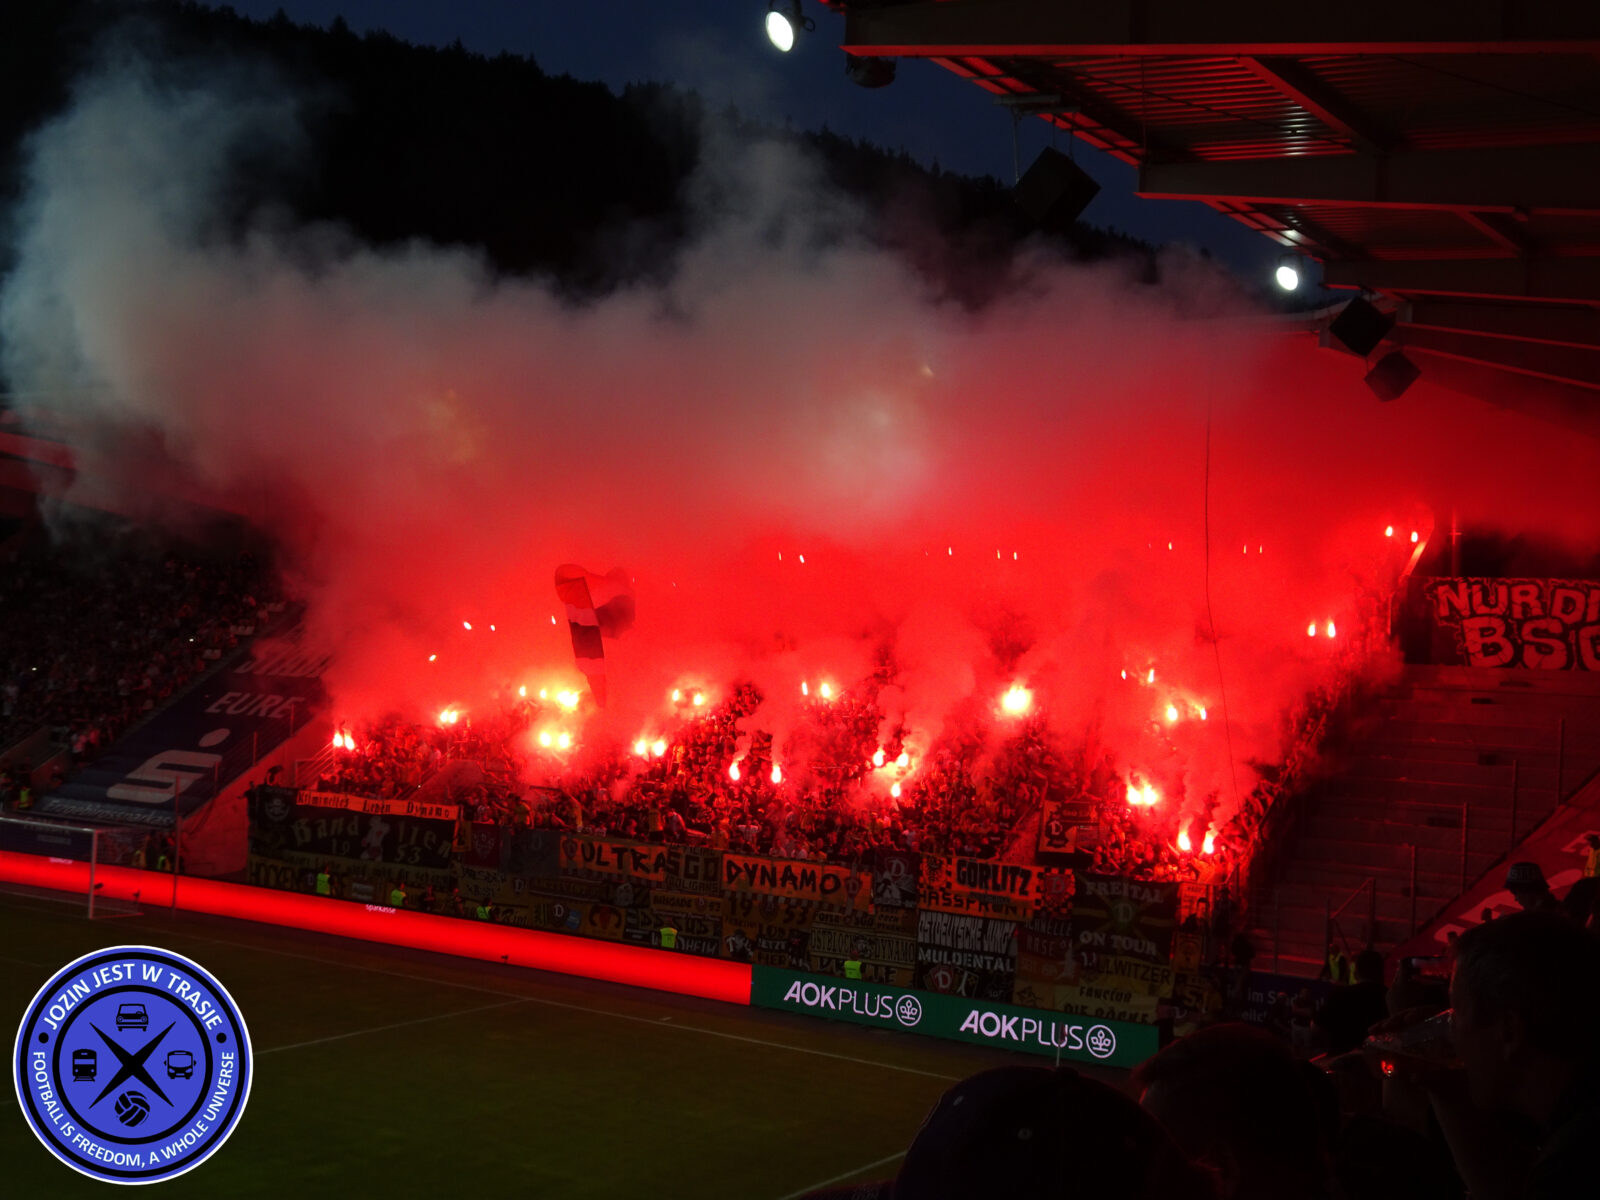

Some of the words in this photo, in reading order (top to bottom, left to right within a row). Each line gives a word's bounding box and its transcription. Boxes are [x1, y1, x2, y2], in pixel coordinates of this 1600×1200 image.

[1437, 582, 1542, 620] NUR
[726, 859, 841, 895] DYNAMO
[1085, 880, 1164, 904] FREITAL
[1079, 930, 1105, 947] ON
[1109, 934, 1159, 957] TOUR
[918, 946, 1016, 973] MULDENTAL
